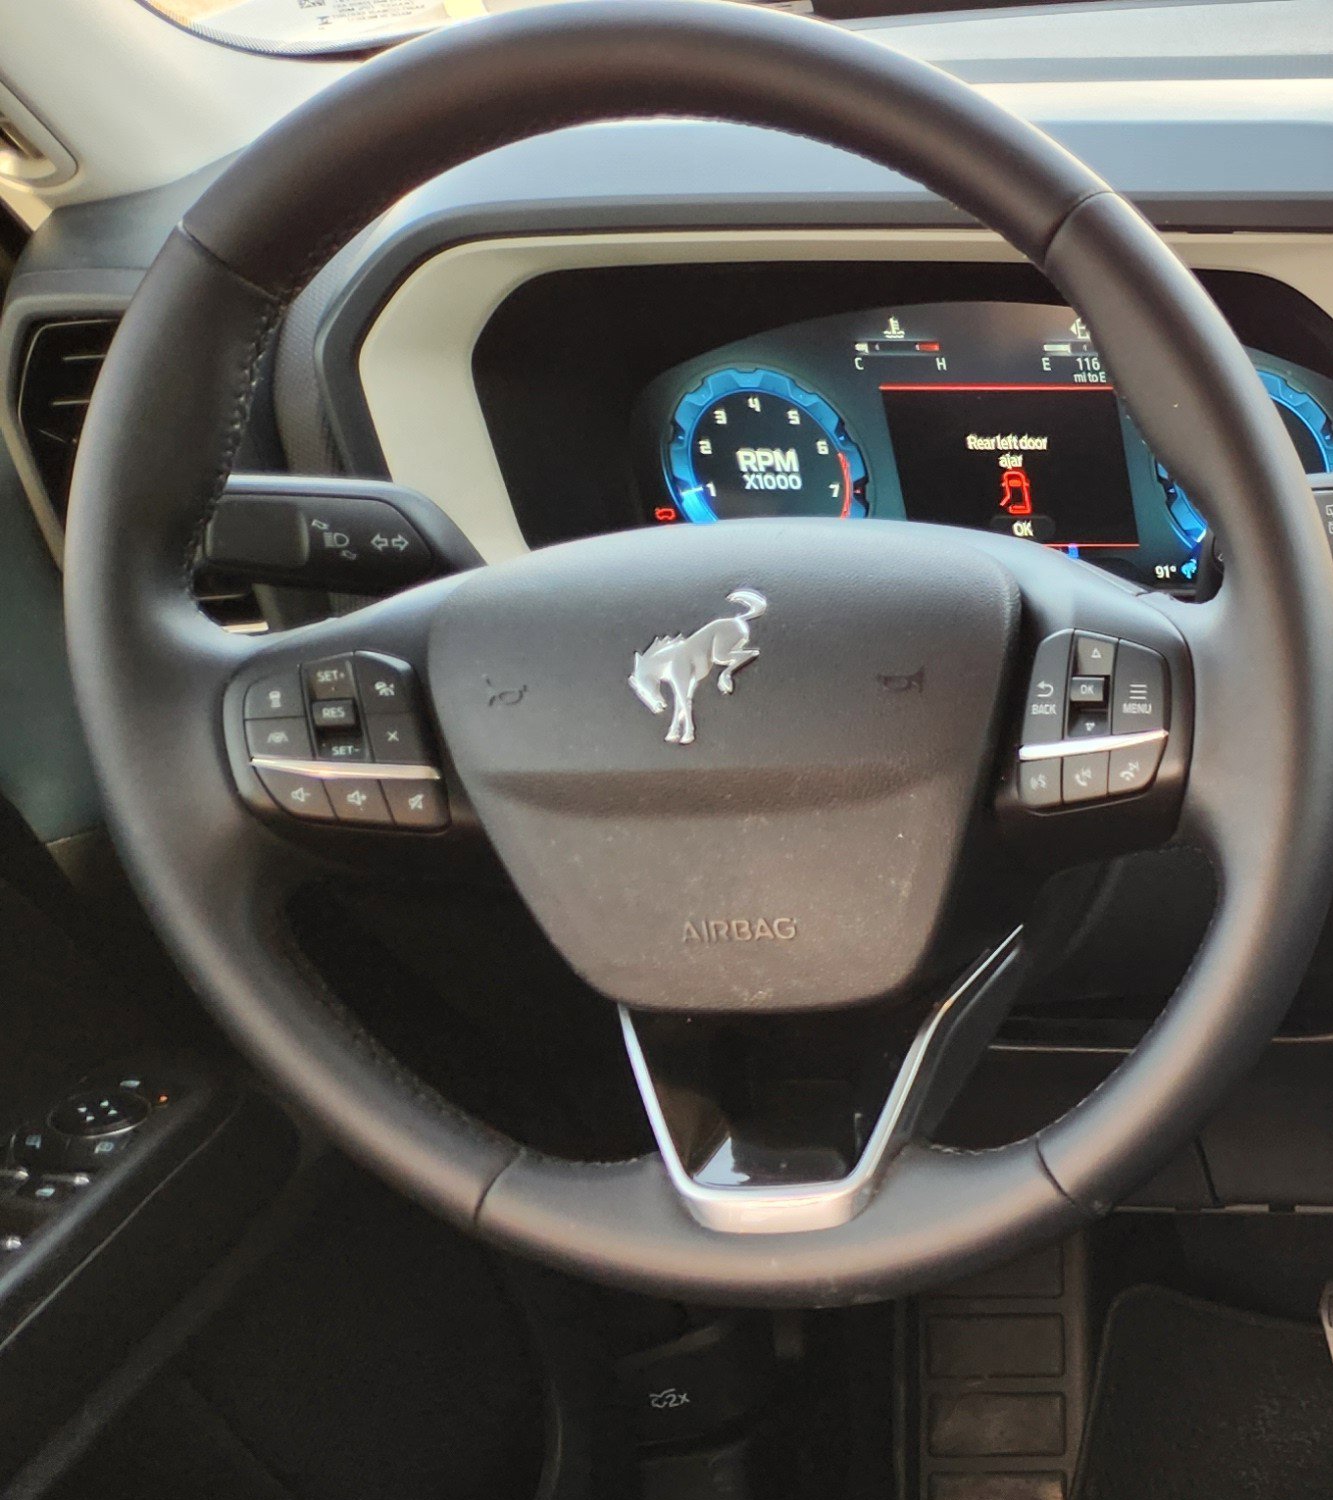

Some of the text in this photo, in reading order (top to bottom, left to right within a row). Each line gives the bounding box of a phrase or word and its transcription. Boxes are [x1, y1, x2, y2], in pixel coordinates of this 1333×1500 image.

[854, 358, 865, 371] C
[935, 358, 947, 371] H
[1041, 357, 1052, 371] E
[1075, 357, 1101, 371] 116
[1087, 371, 1099, 383] to
[1098, 371, 1107, 383] E
[748, 396, 761, 412] 4
[713, 408, 728, 425] 3
[786, 409, 801, 425] 5
[698, 437, 712, 455] 2
[815, 438, 829, 455] 6
[966, 432, 1048, 450] Rear left door
[735, 447, 800, 472] RPM
[998, 451, 1023, 469] ajar
[705, 481, 717, 497] 1
[742, 473, 802, 490] X1000
[828, 481, 840, 498] 7
[1012, 520, 1034, 537] OK
[1154, 564, 1177, 579] 91°
[1080, 683, 1095, 695] OK
[322, 707, 345, 718] RES
[1030, 703, 1057, 716] BACK
[1122, 702, 1152, 715] MENU
[681, 916, 799, 943] AIRBAG
